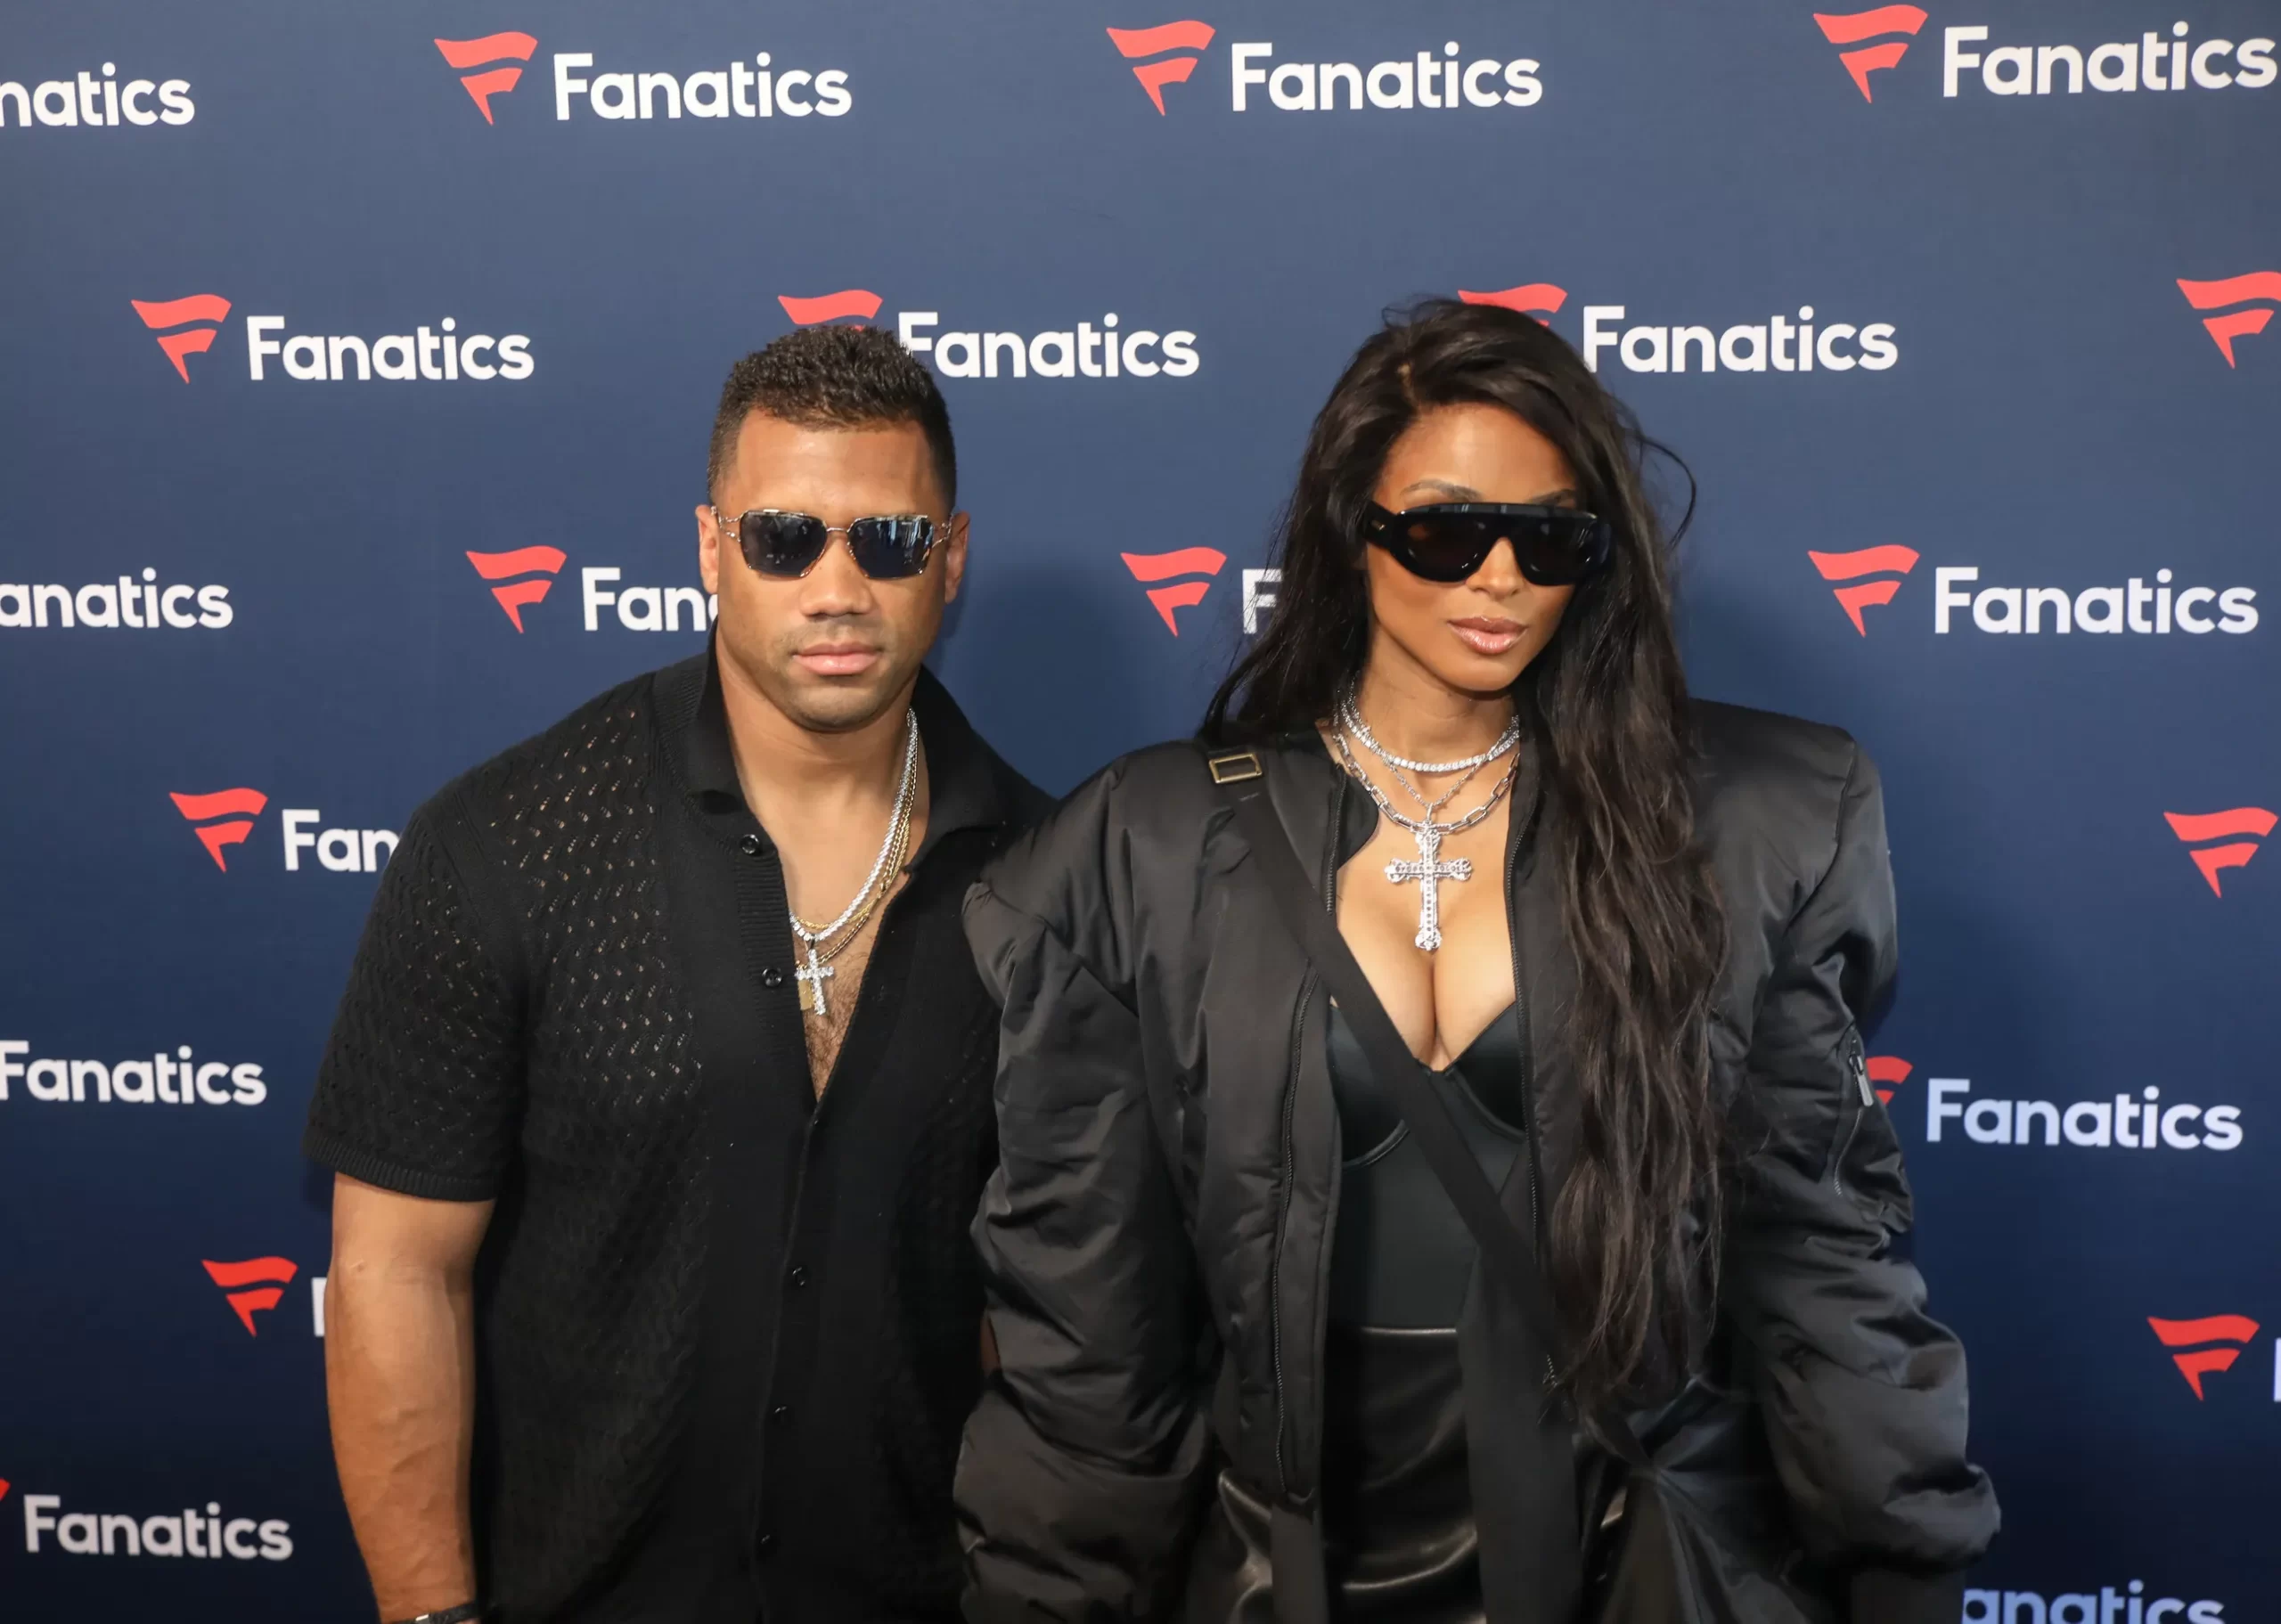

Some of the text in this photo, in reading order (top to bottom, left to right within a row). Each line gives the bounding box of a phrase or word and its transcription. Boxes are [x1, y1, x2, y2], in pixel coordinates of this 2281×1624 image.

[553, 51, 853, 121] Fanatics
[1231, 40, 1543, 112] Fanatics
[1942, 20, 2277, 98] Fanatics
[246, 315, 535, 380] Fanatics
[898, 311, 1200, 379] Fanatics
[1582, 305, 1899, 373] Fanatics
[0, 567, 233, 629] anatics
[1934, 567, 2259, 634] Fanatics
[0, 1040, 267, 1106] Fanatics
[1927, 1079, 2244, 1151] Fanatics
[24, 1495, 293, 1560] Fanatics
